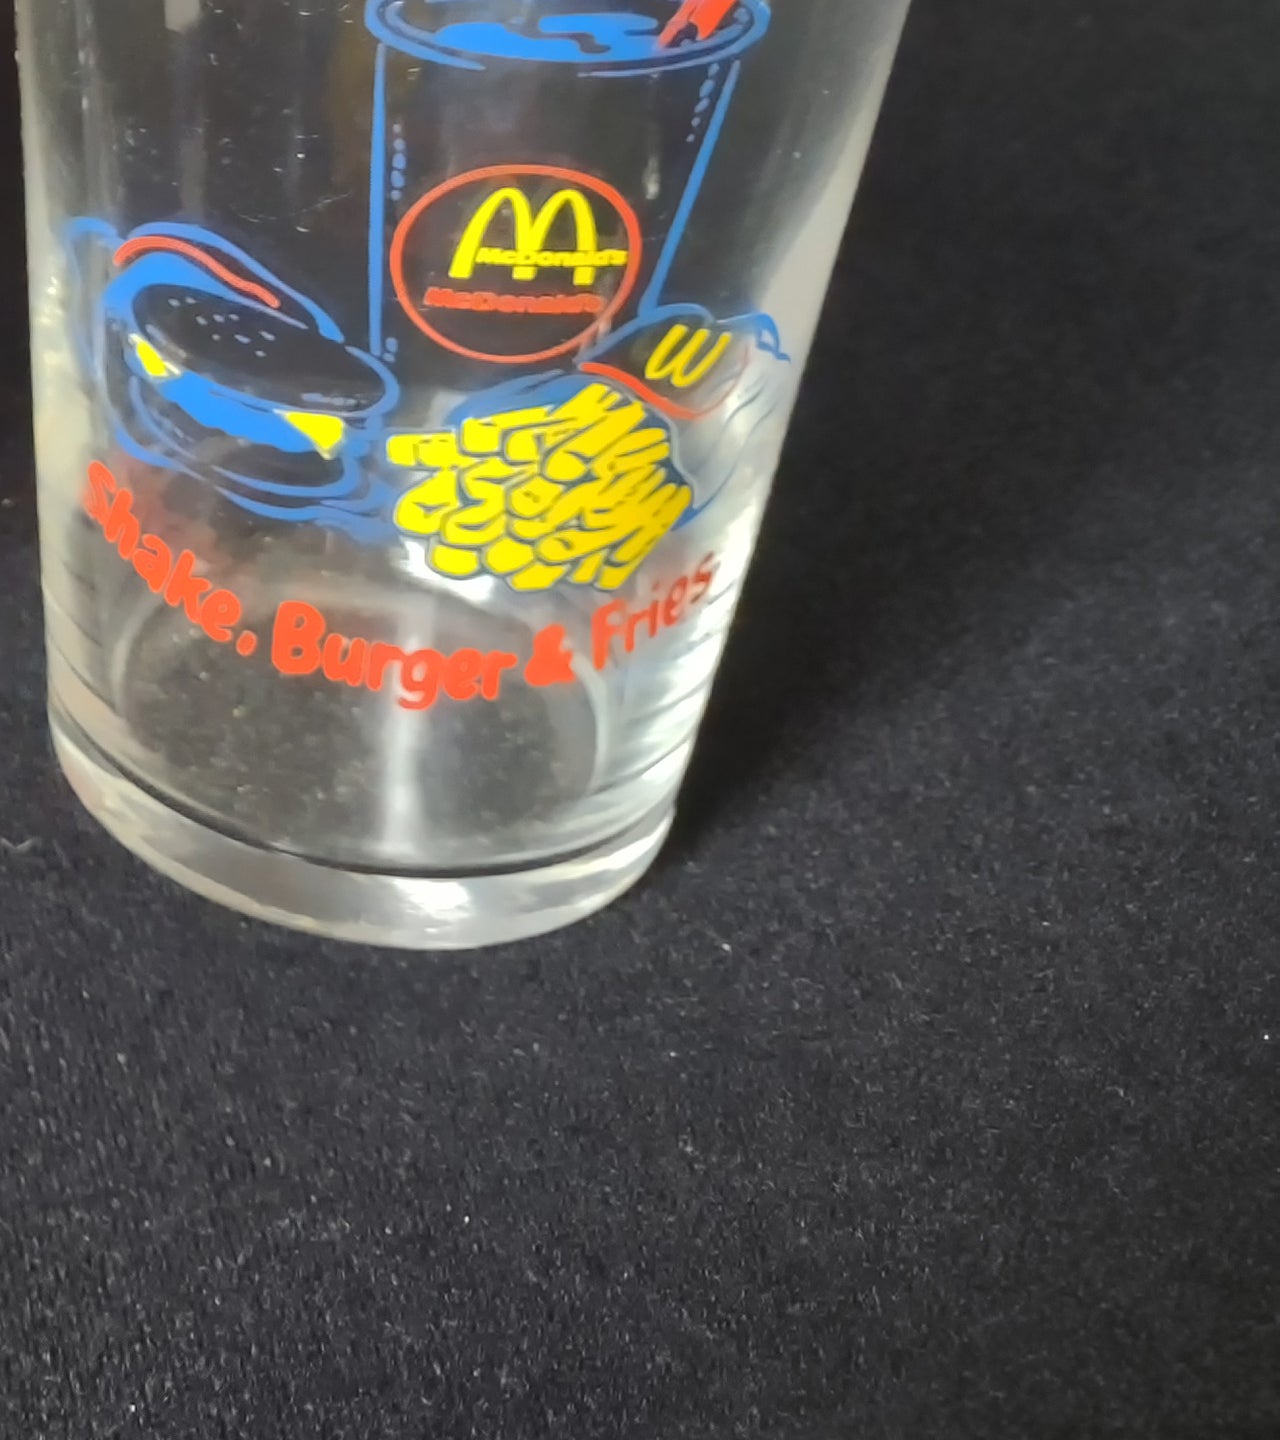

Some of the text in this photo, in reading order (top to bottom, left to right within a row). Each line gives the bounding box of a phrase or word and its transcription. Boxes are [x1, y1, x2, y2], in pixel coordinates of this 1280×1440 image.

[271, 601, 518, 710] Burger
[524, 624, 575, 686] &
[592, 552, 715, 670] Fries
